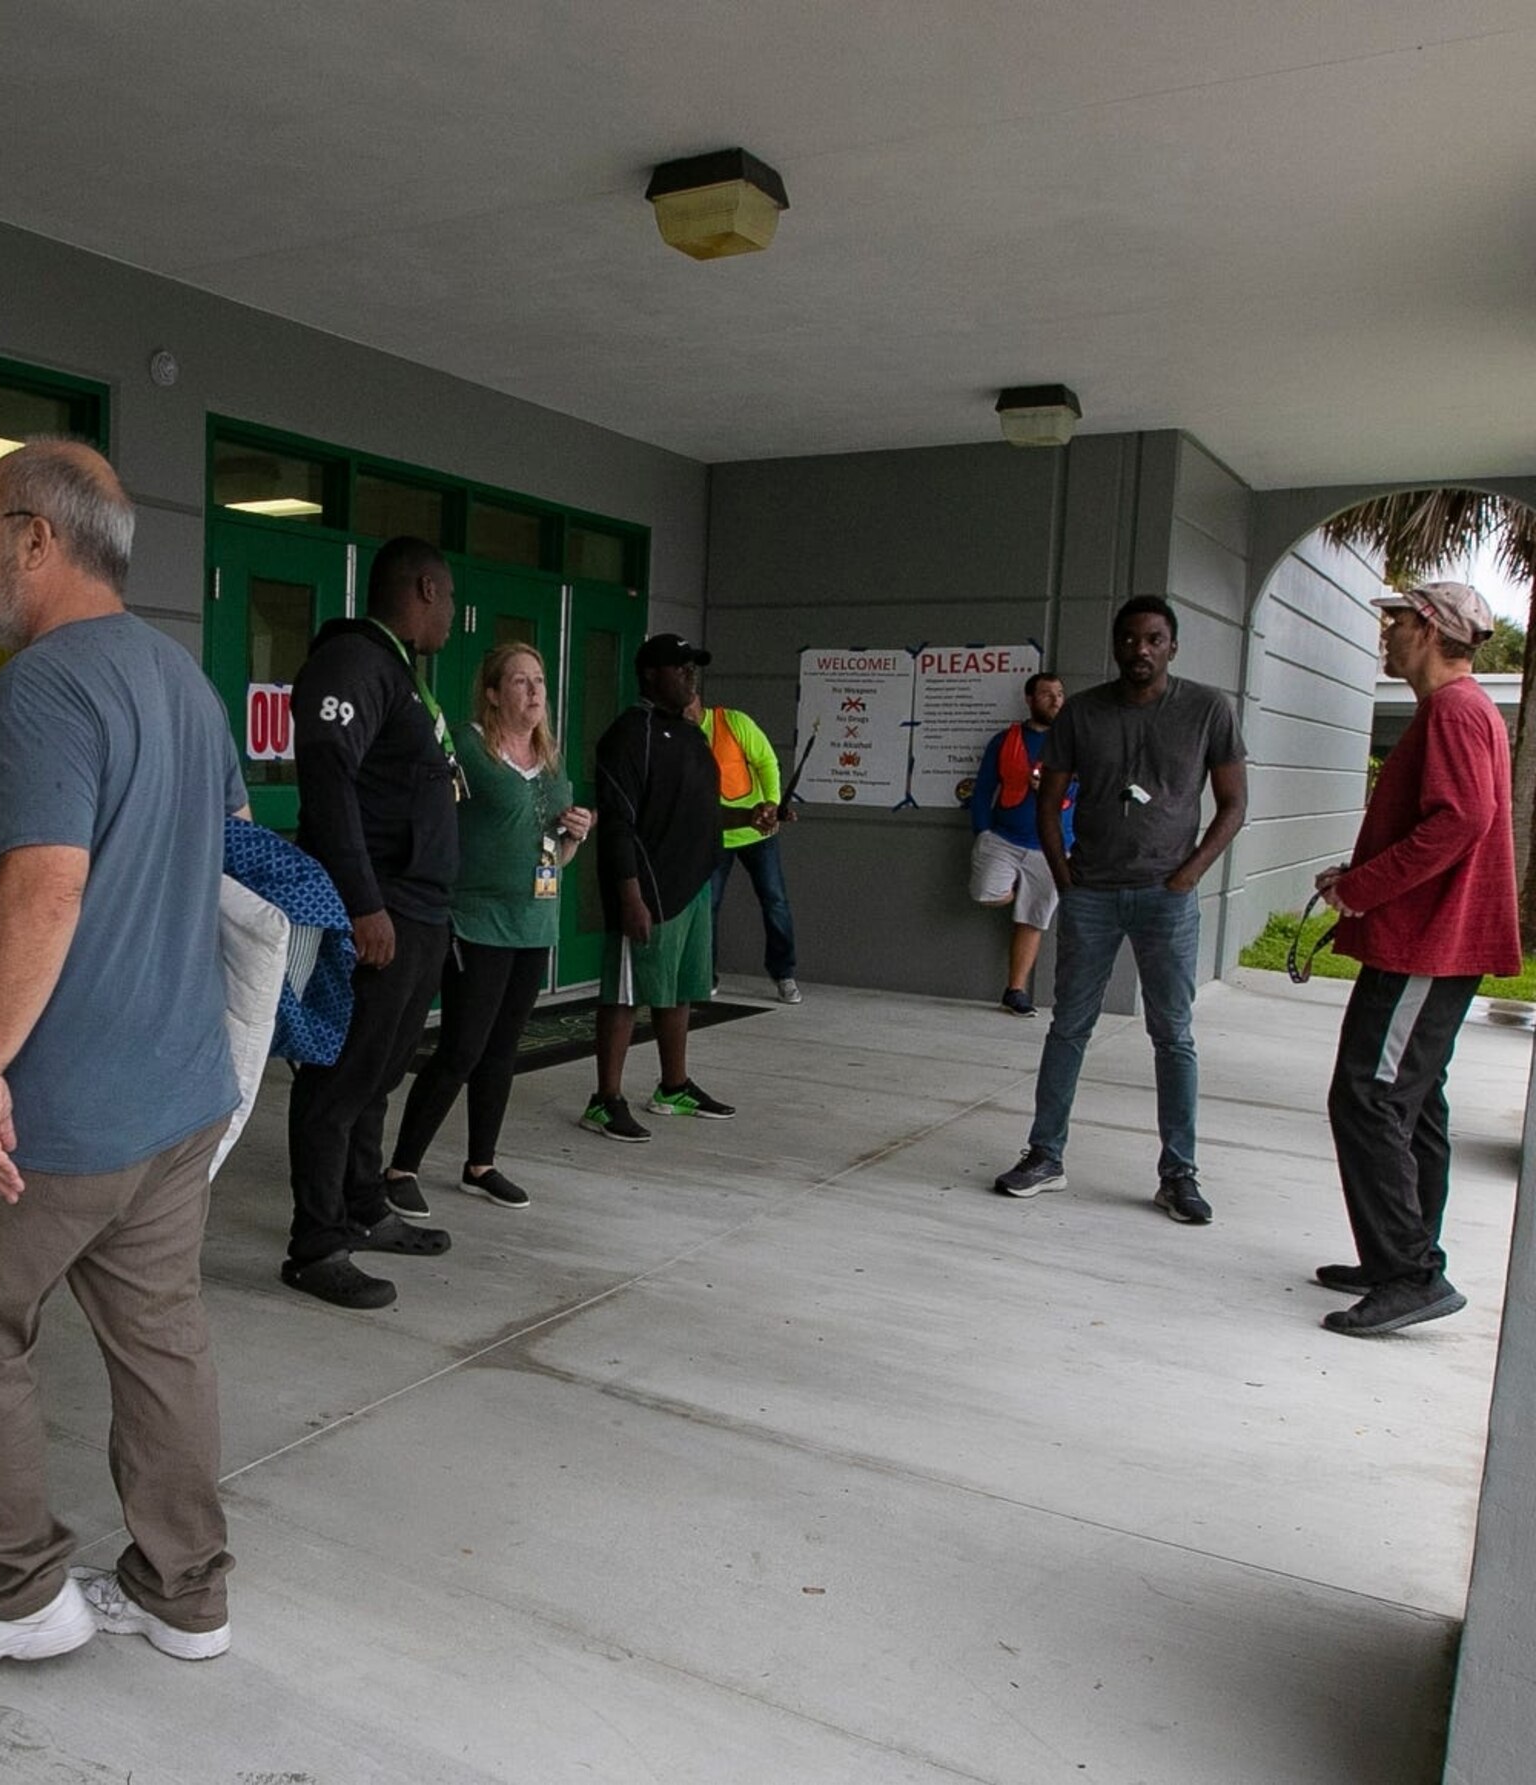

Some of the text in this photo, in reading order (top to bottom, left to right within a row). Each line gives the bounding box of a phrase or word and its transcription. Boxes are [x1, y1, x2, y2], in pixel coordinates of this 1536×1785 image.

[817, 656, 897, 671] WELCOME!
[921, 652, 1032, 675] PLEASE...
[832, 686, 878, 696] No Weapons
[319, 695, 356, 727] 89
[250, 691, 291, 754] OU
[836, 715, 869, 724] No Drugs
[830, 741, 872, 750] No Alcohol
[947, 755, 975, 764] Thank
